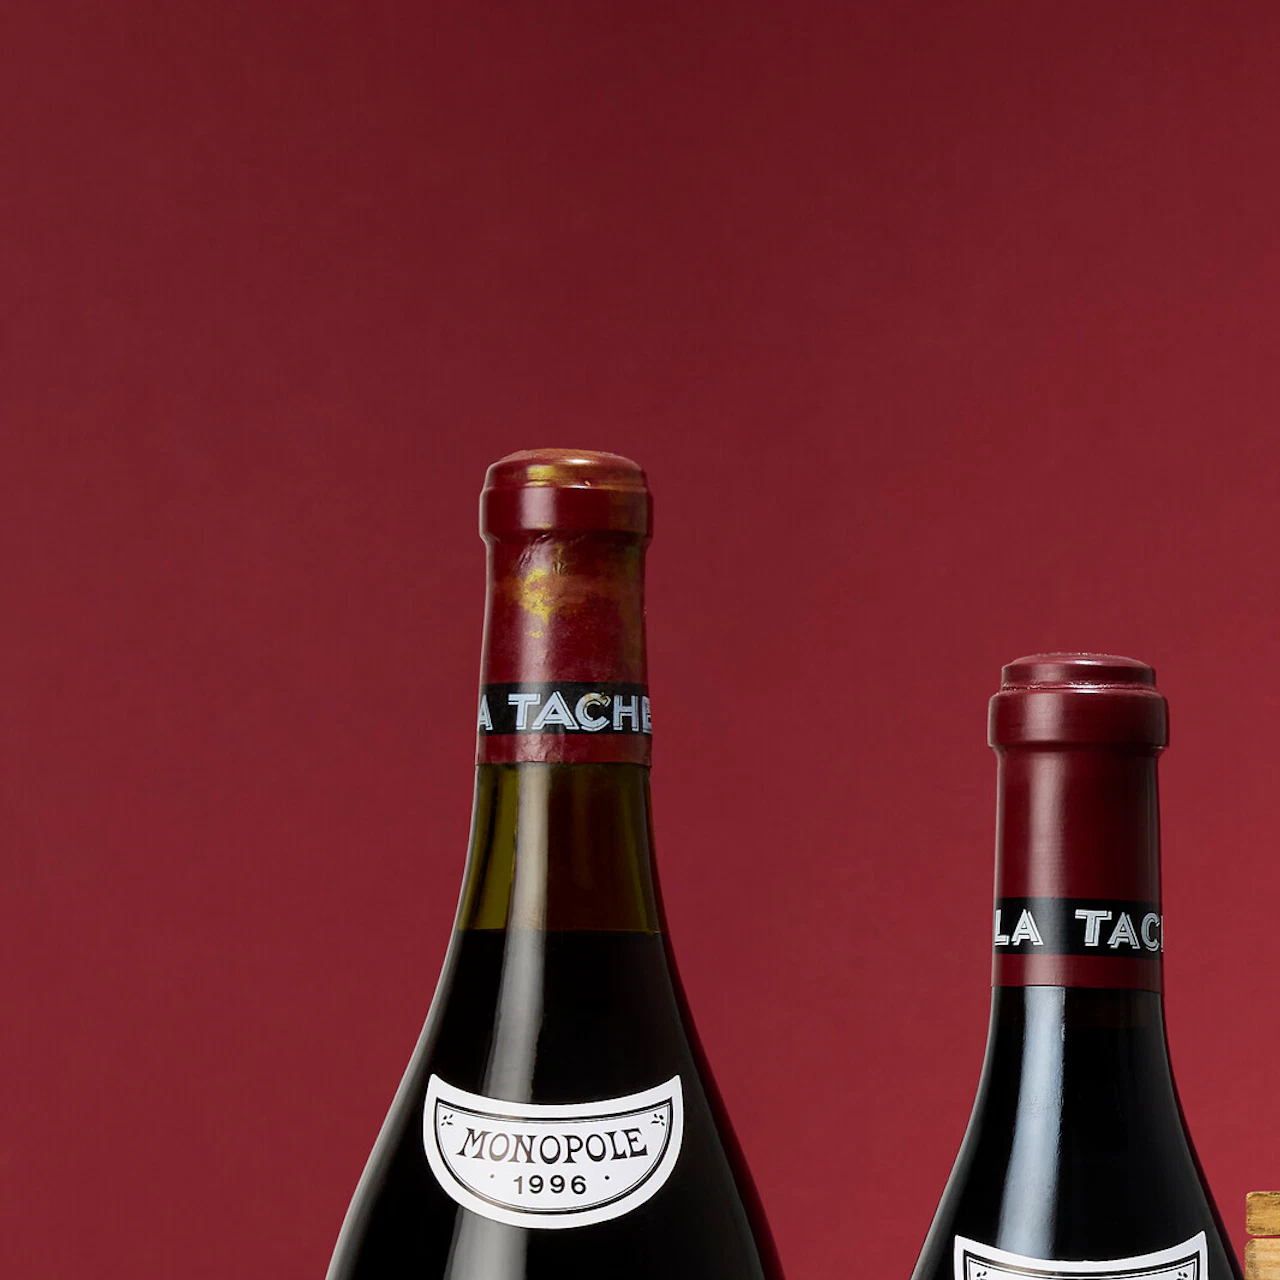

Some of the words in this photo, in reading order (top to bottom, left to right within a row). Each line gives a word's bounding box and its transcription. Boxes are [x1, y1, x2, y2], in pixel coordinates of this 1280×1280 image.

[995, 909, 1044, 946] LA
[1075, 909, 1163, 952] TAC
[456, 1127, 648, 1164] MONOPOLE
[513, 1175, 587, 1194] 1996
